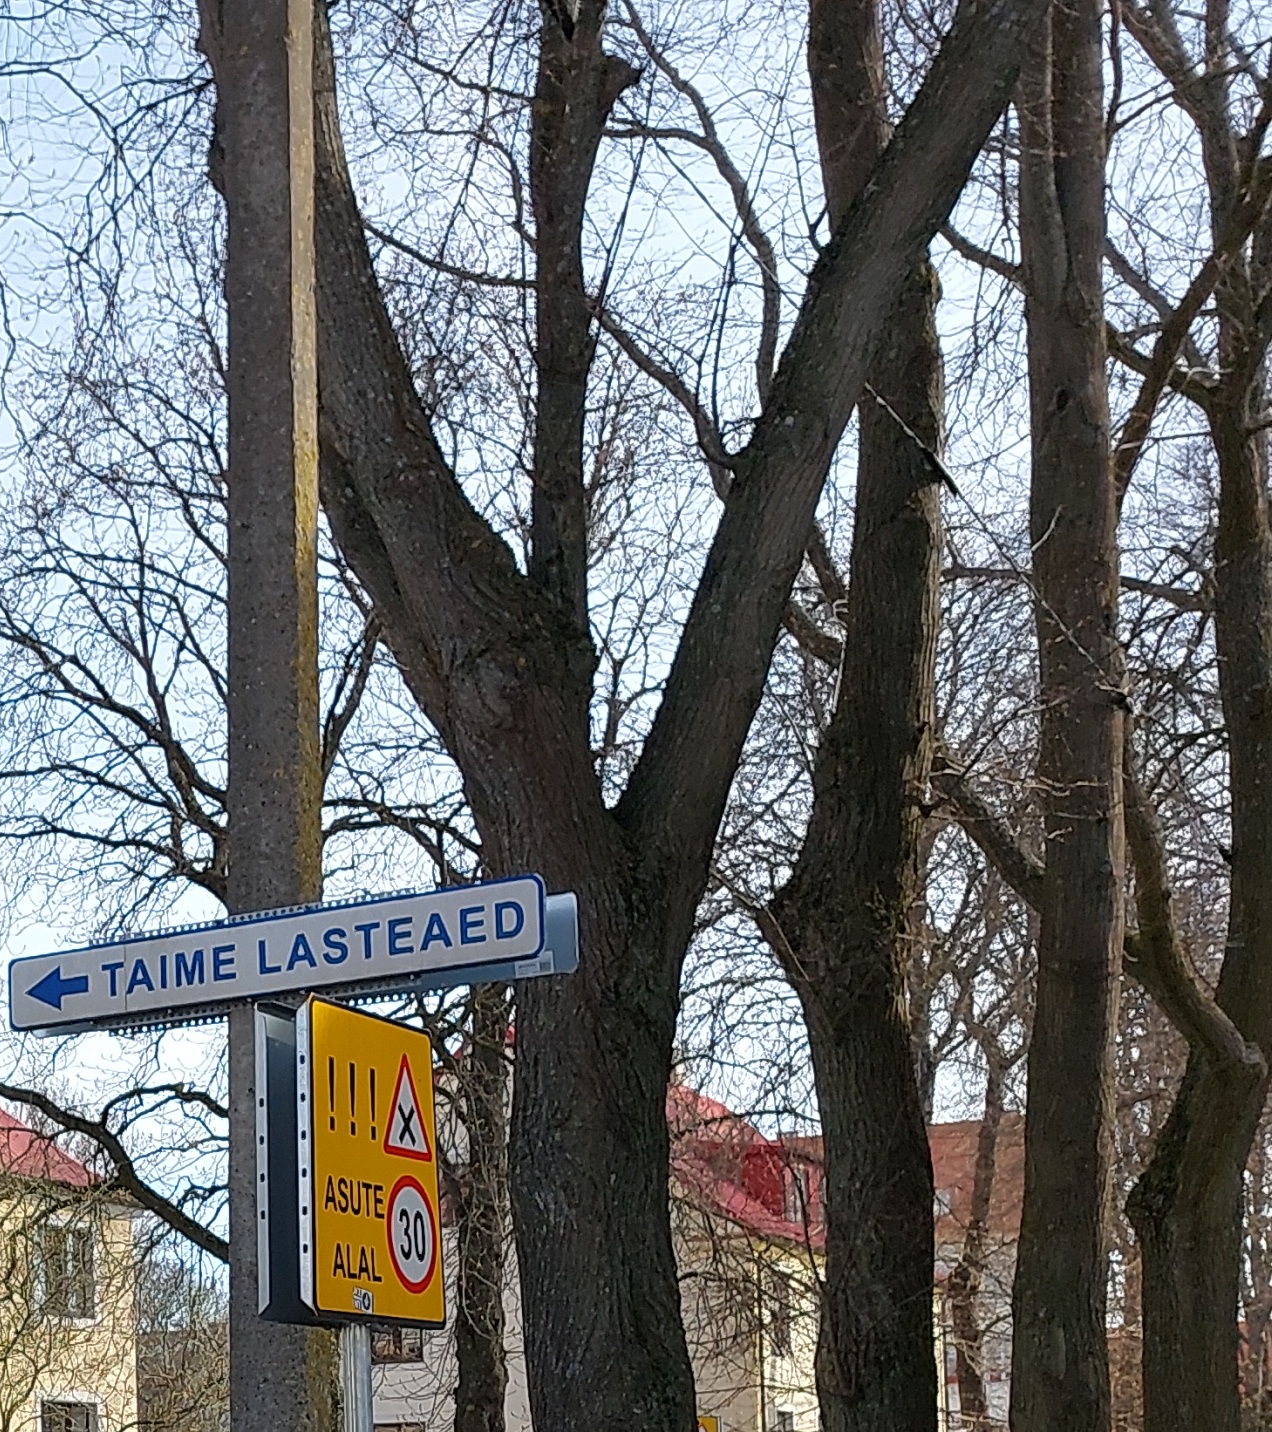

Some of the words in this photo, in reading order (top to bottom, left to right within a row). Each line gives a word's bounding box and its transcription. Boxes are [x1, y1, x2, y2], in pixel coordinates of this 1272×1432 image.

[101, 945, 237, 997] TAIME
[258, 901, 524, 974] LASTEAED
[324, 1175, 385, 1219] ASUTE
[398, 1208, 426, 1262] 30
[333, 1243, 382, 1282] ALAL
